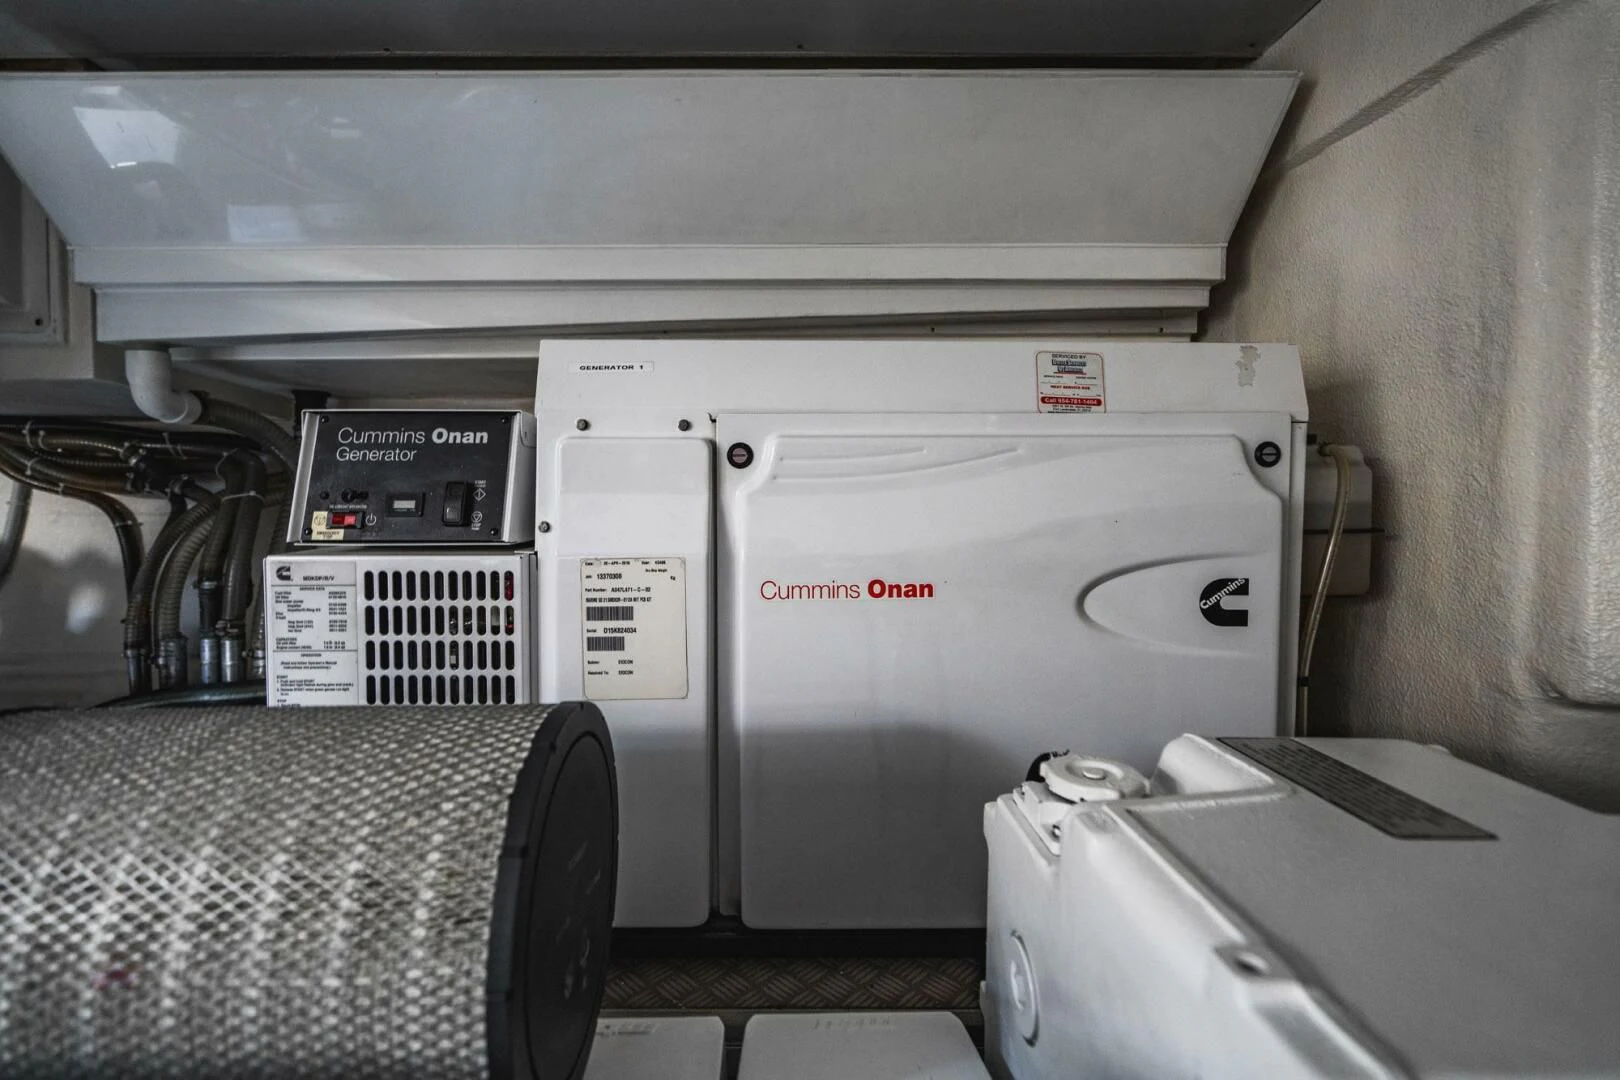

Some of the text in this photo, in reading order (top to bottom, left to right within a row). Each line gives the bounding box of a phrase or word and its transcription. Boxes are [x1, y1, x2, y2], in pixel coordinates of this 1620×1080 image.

[338, 426, 489, 444] Cummins Onan
[336, 446, 417, 462] Generator
[760, 579, 935, 600] Cummins Onan
[1200, 579, 1246, 609] Cummins
